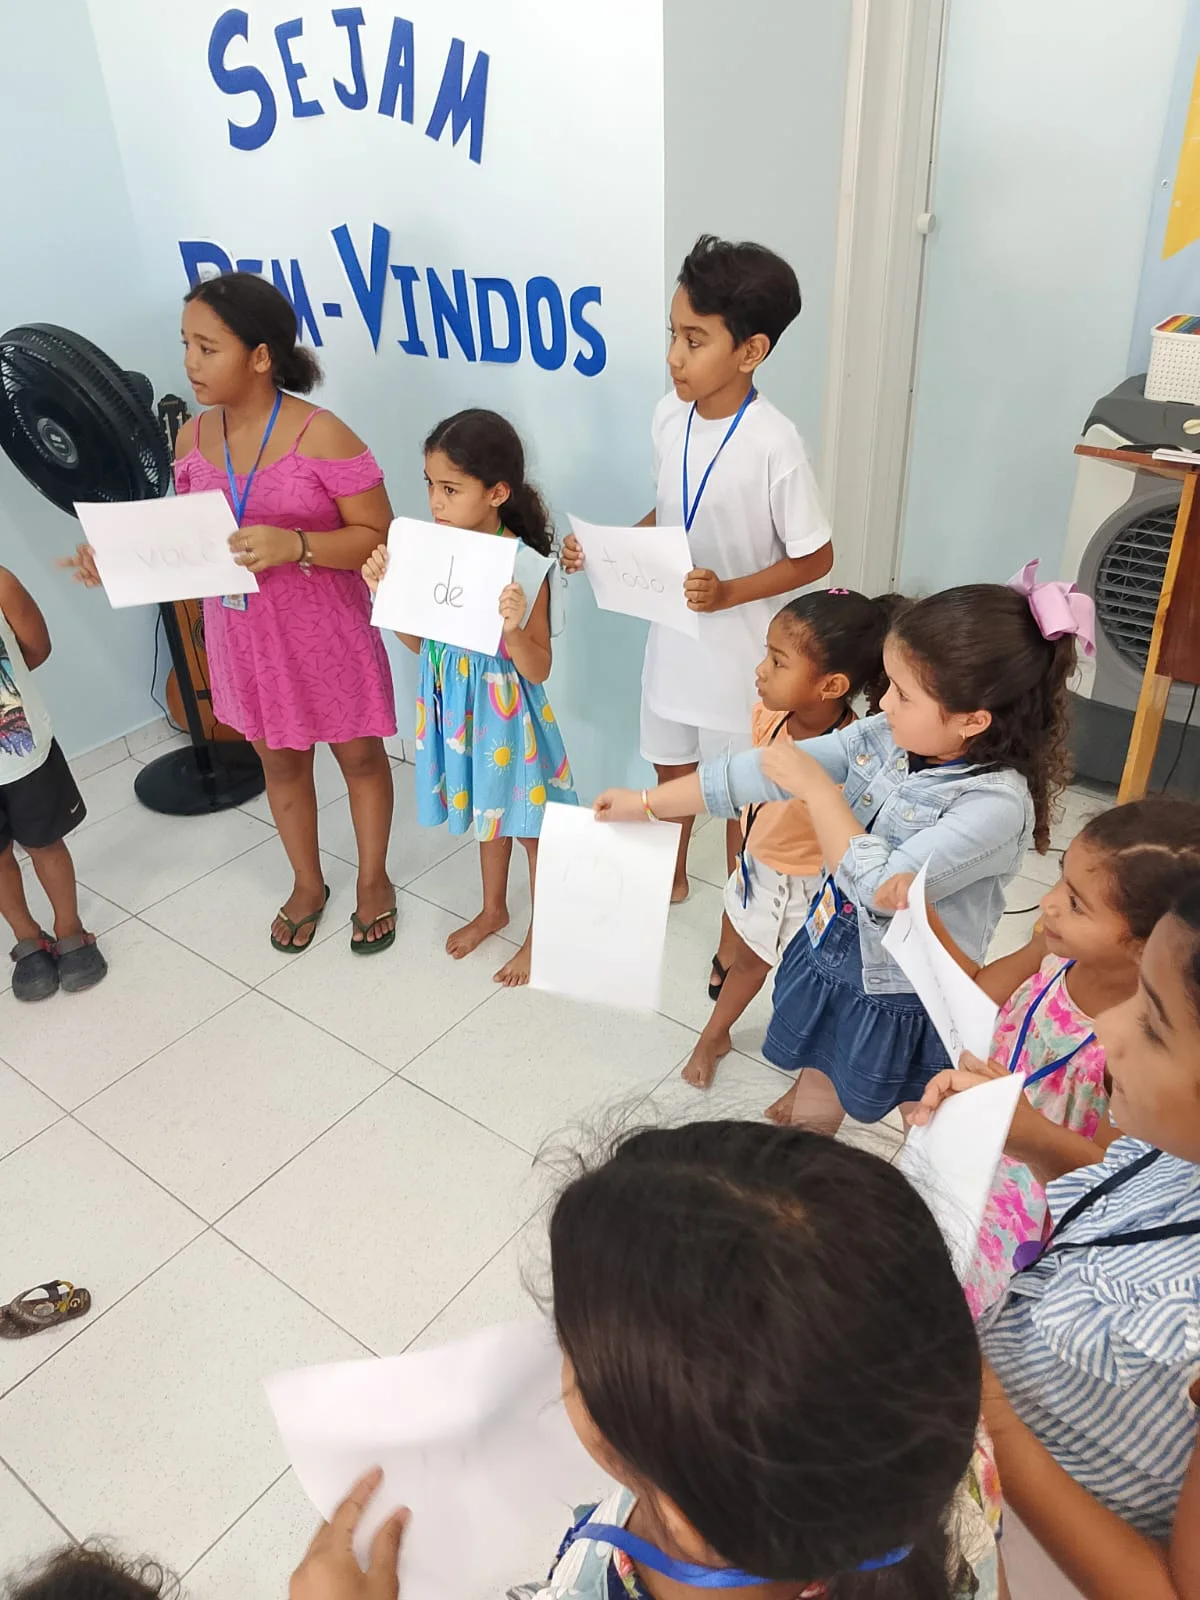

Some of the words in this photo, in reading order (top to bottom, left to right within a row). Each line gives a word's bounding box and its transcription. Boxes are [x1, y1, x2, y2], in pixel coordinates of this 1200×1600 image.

[208, 8, 489, 163] SEJAM
[178, 223, 607, 377] M-VINDOS
[433, 555, 463, 608] de
[601, 545, 665, 593] todo
